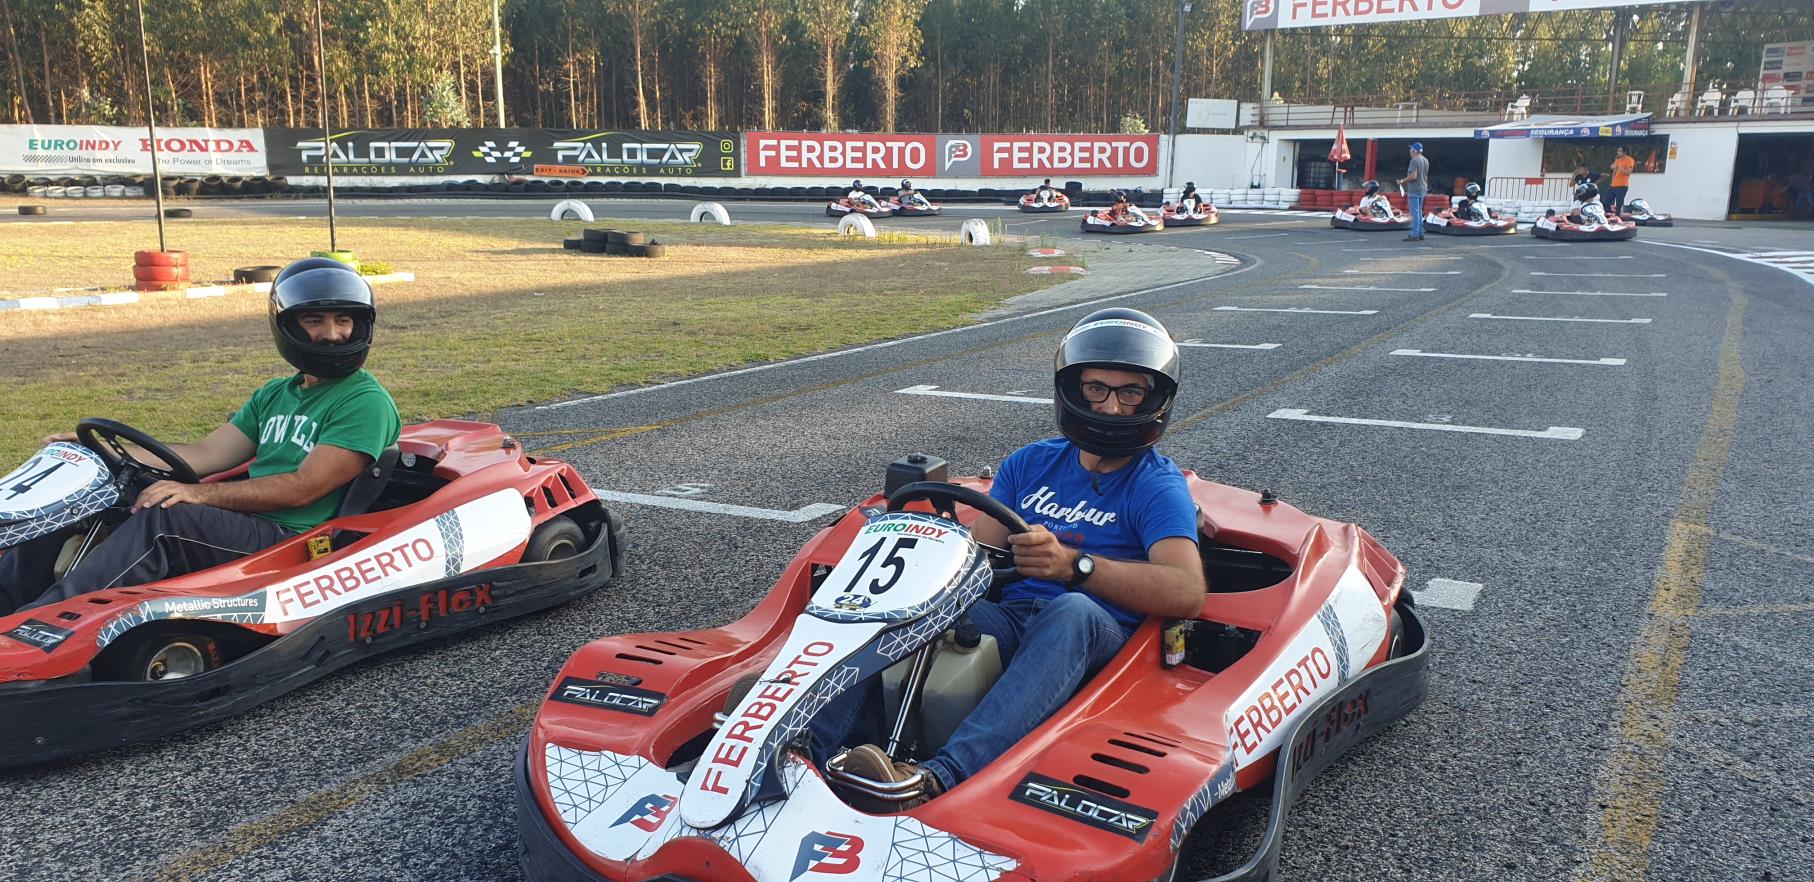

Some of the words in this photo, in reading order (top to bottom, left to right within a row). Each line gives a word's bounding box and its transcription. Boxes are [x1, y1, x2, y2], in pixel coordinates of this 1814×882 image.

[1530, 128, 1574, 136] SEGURANÇA
[28, 138, 123, 151] EUROINDY
[138, 138, 258, 153] HONDA
[296, 141, 454, 164] PALOCAR
[552, 142, 702, 164] PALOCAR
[104, 156, 136, 164] exclusivo
[172, 157, 201, 165] Power
[215, 157, 252, 166] Dreams
[758, 139, 926, 170] FERBERTO
[993, 141, 1149, 169] FERBERTO
[304, 164, 397, 174] REARAÇÕES
[409, 165, 445, 174] AUTO
[586, 165, 647, 174] ARAÇÕES
[659, 166, 693, 175] AUTO
[864, 522, 949, 539] EUROINDY
[843, 536, 919, 595] 15
[275, 537, 435, 617] FERBERTO
[164, 598, 211, 613] Metallic
[211, 596, 258, 609] Structures
[562, 685, 661, 710] PALOCAR
[700, 641, 835, 795] FERBERTO
[1023, 781, 1150, 832] PALOCAR
